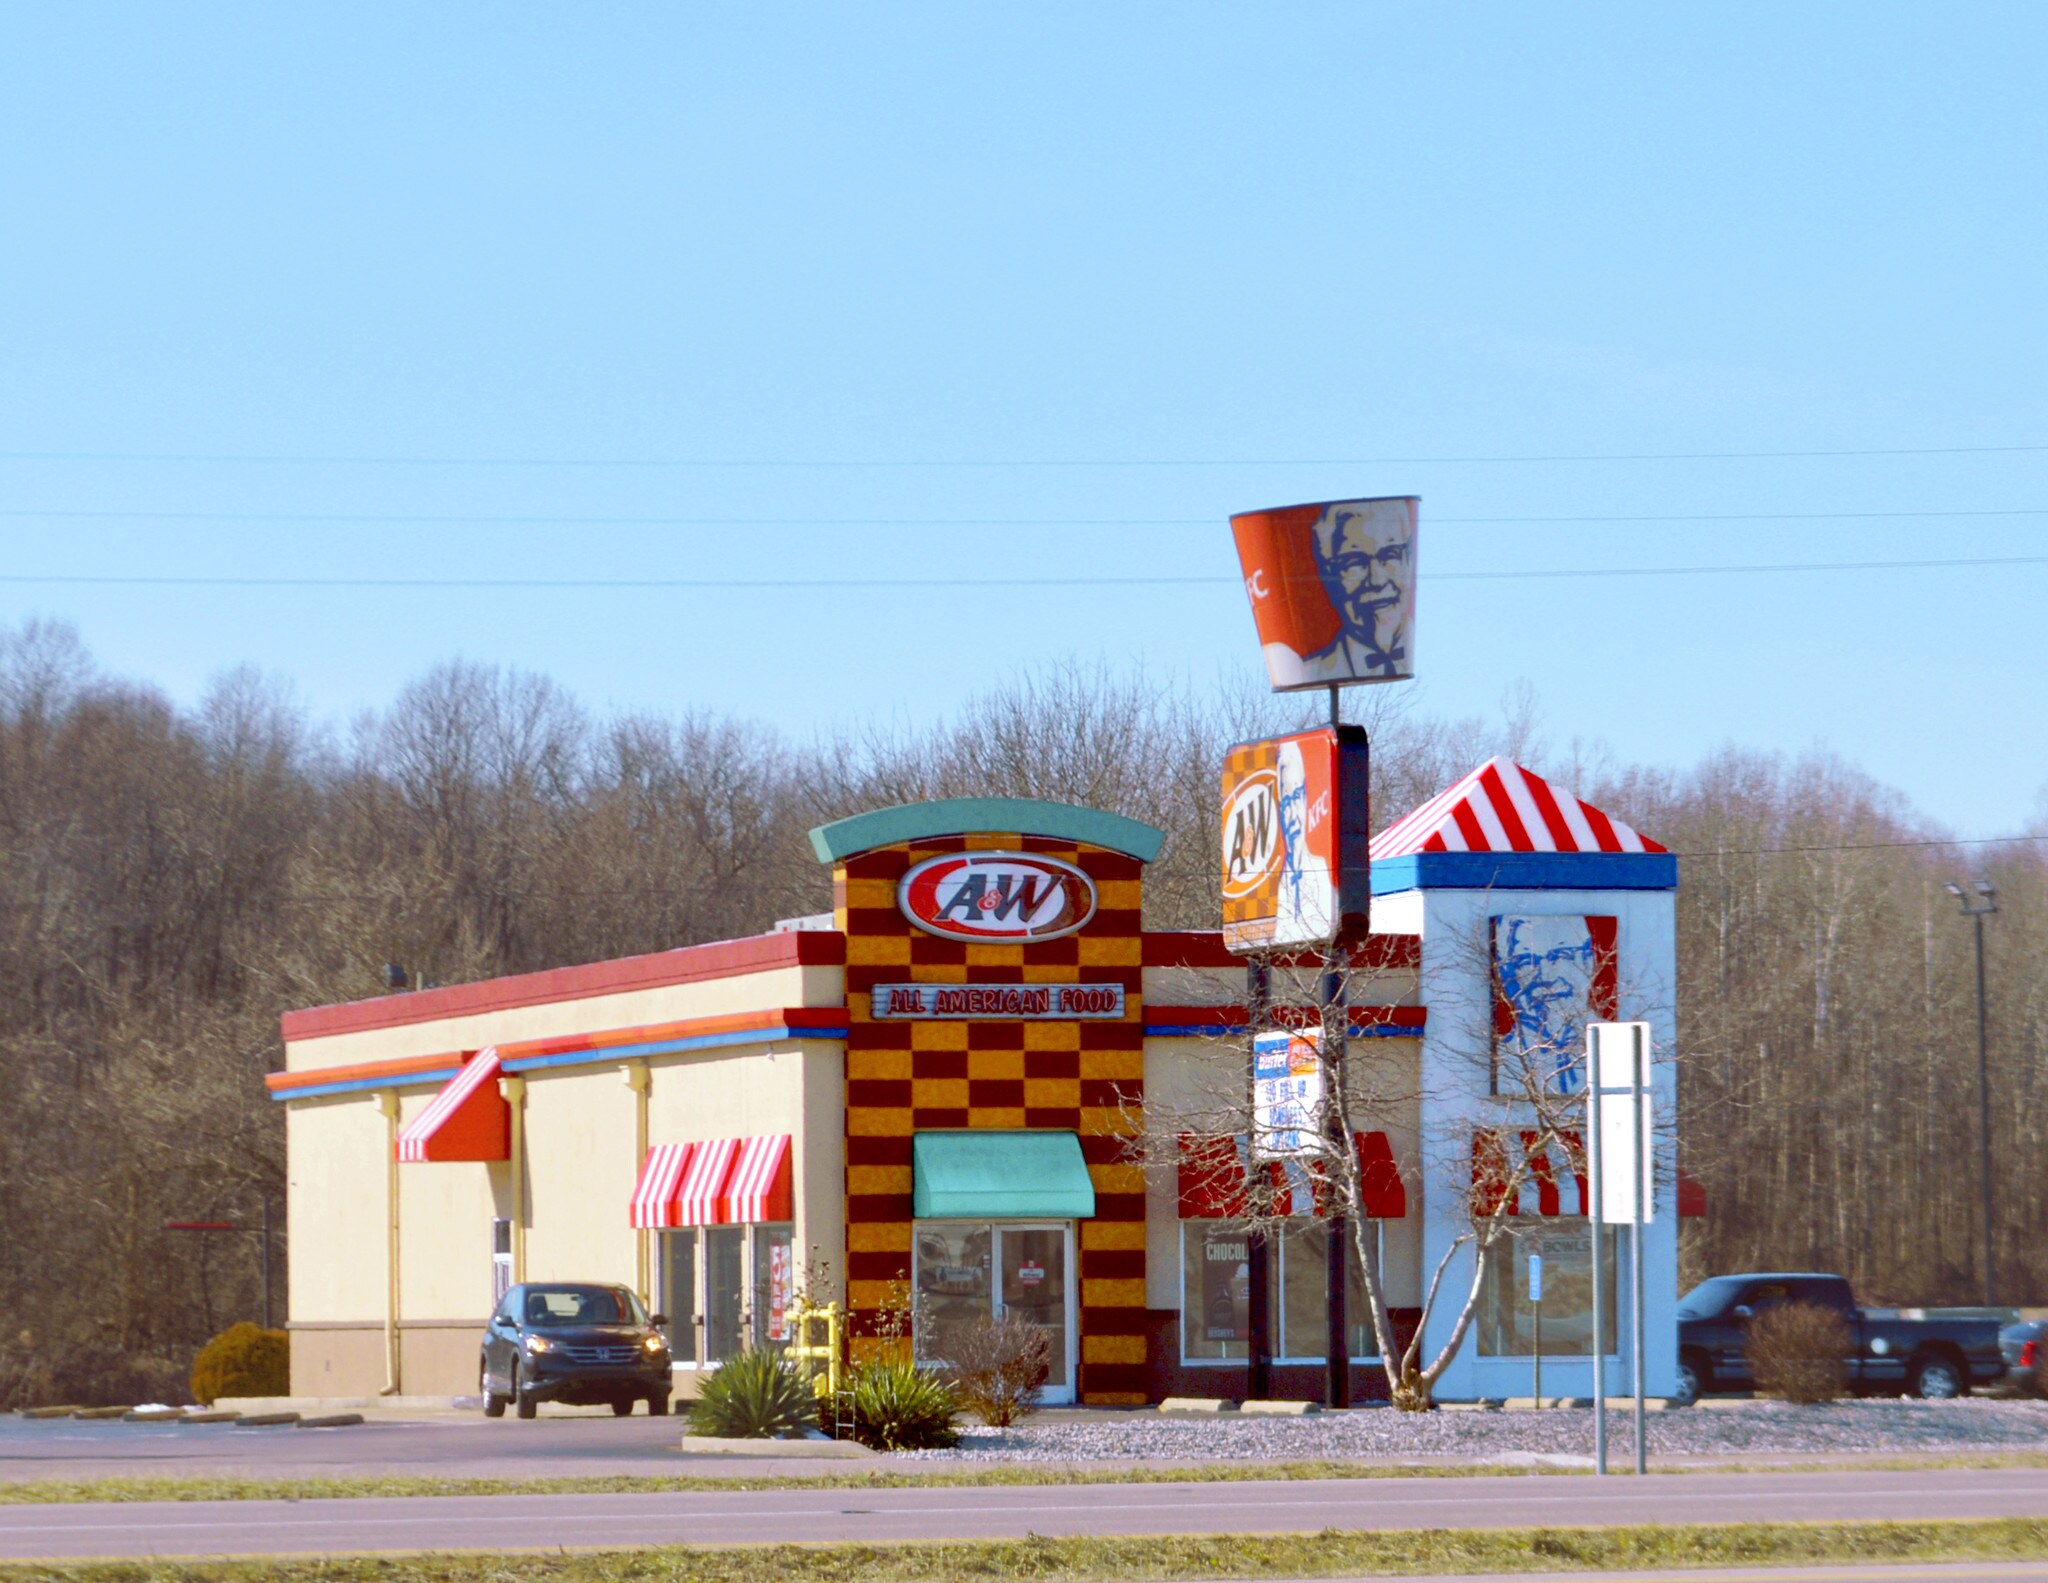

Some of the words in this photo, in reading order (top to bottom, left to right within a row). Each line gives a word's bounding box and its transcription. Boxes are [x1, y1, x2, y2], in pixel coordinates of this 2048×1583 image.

[1225, 781, 1273, 887] A&W
[1308, 790, 1328, 833] KFC
[931, 873, 1065, 922] A&W
[887, 988, 926, 1015] ALL
[933, 987, 1049, 1015] AMERICAN
[1059, 987, 1117, 1013] FOOD
